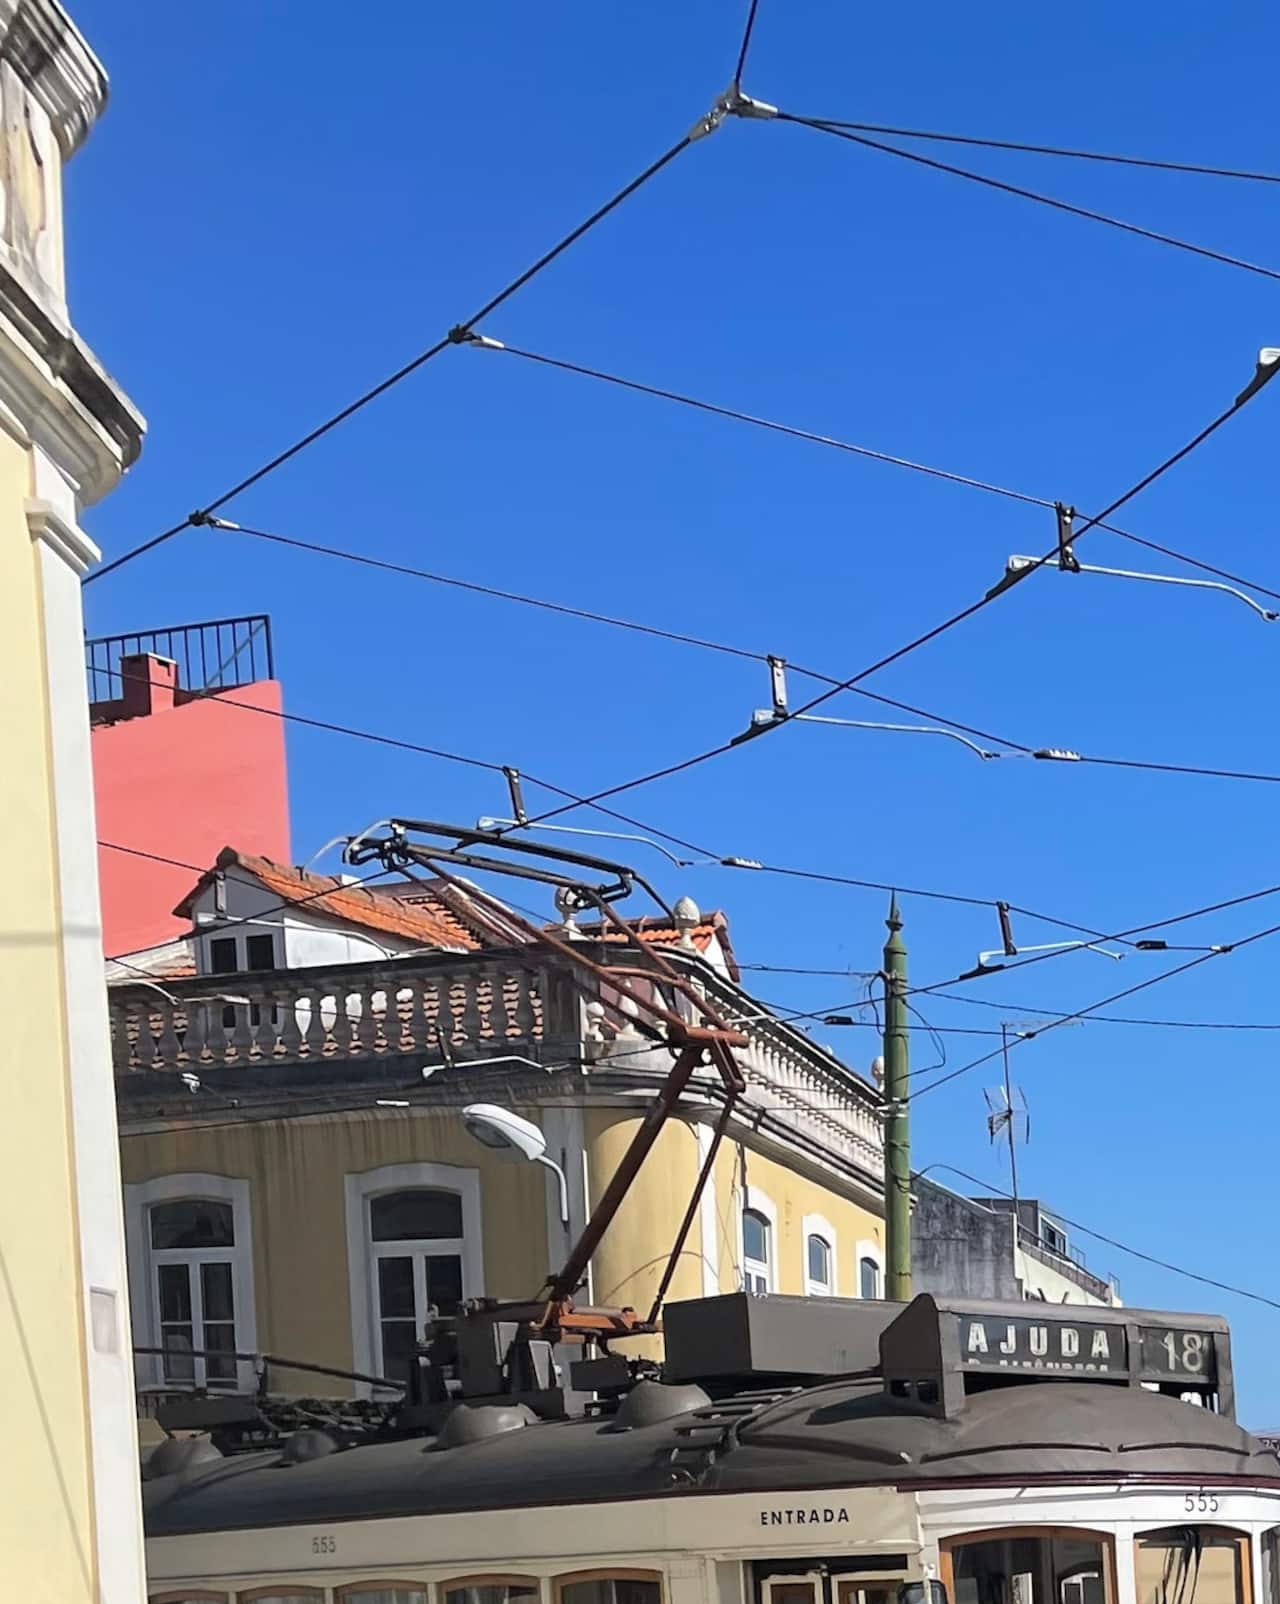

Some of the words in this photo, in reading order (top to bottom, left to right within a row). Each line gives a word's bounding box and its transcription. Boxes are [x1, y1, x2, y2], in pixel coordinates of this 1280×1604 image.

[968, 1322, 1110, 1358] AJUDA
[1184, 1492, 1219, 1512] 555
[761, 1508, 849, 1525] ENTRADA
[311, 1535, 337, 1553] 555
